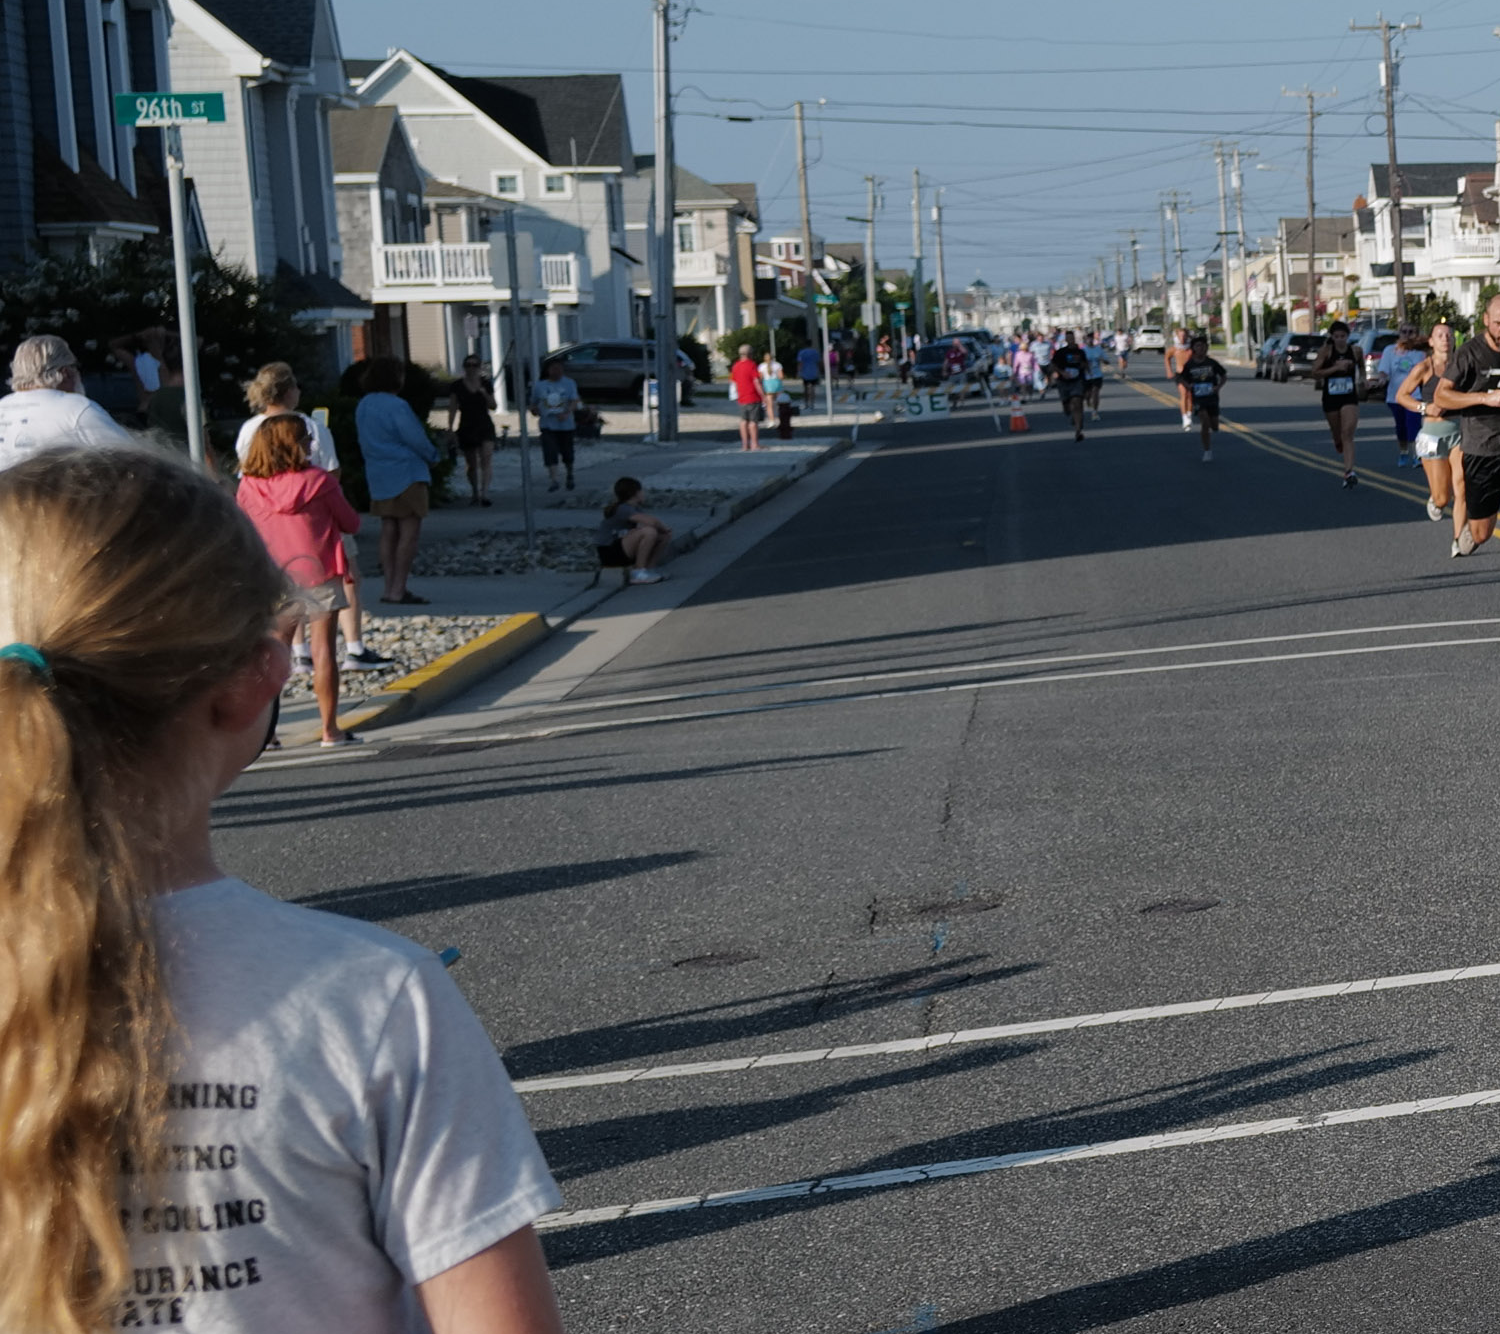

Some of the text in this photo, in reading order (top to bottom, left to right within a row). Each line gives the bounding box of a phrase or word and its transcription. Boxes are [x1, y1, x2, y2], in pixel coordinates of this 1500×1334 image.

[135, 96, 206, 120] 96th ST
[124, 1256, 263, 1297] URANCE
